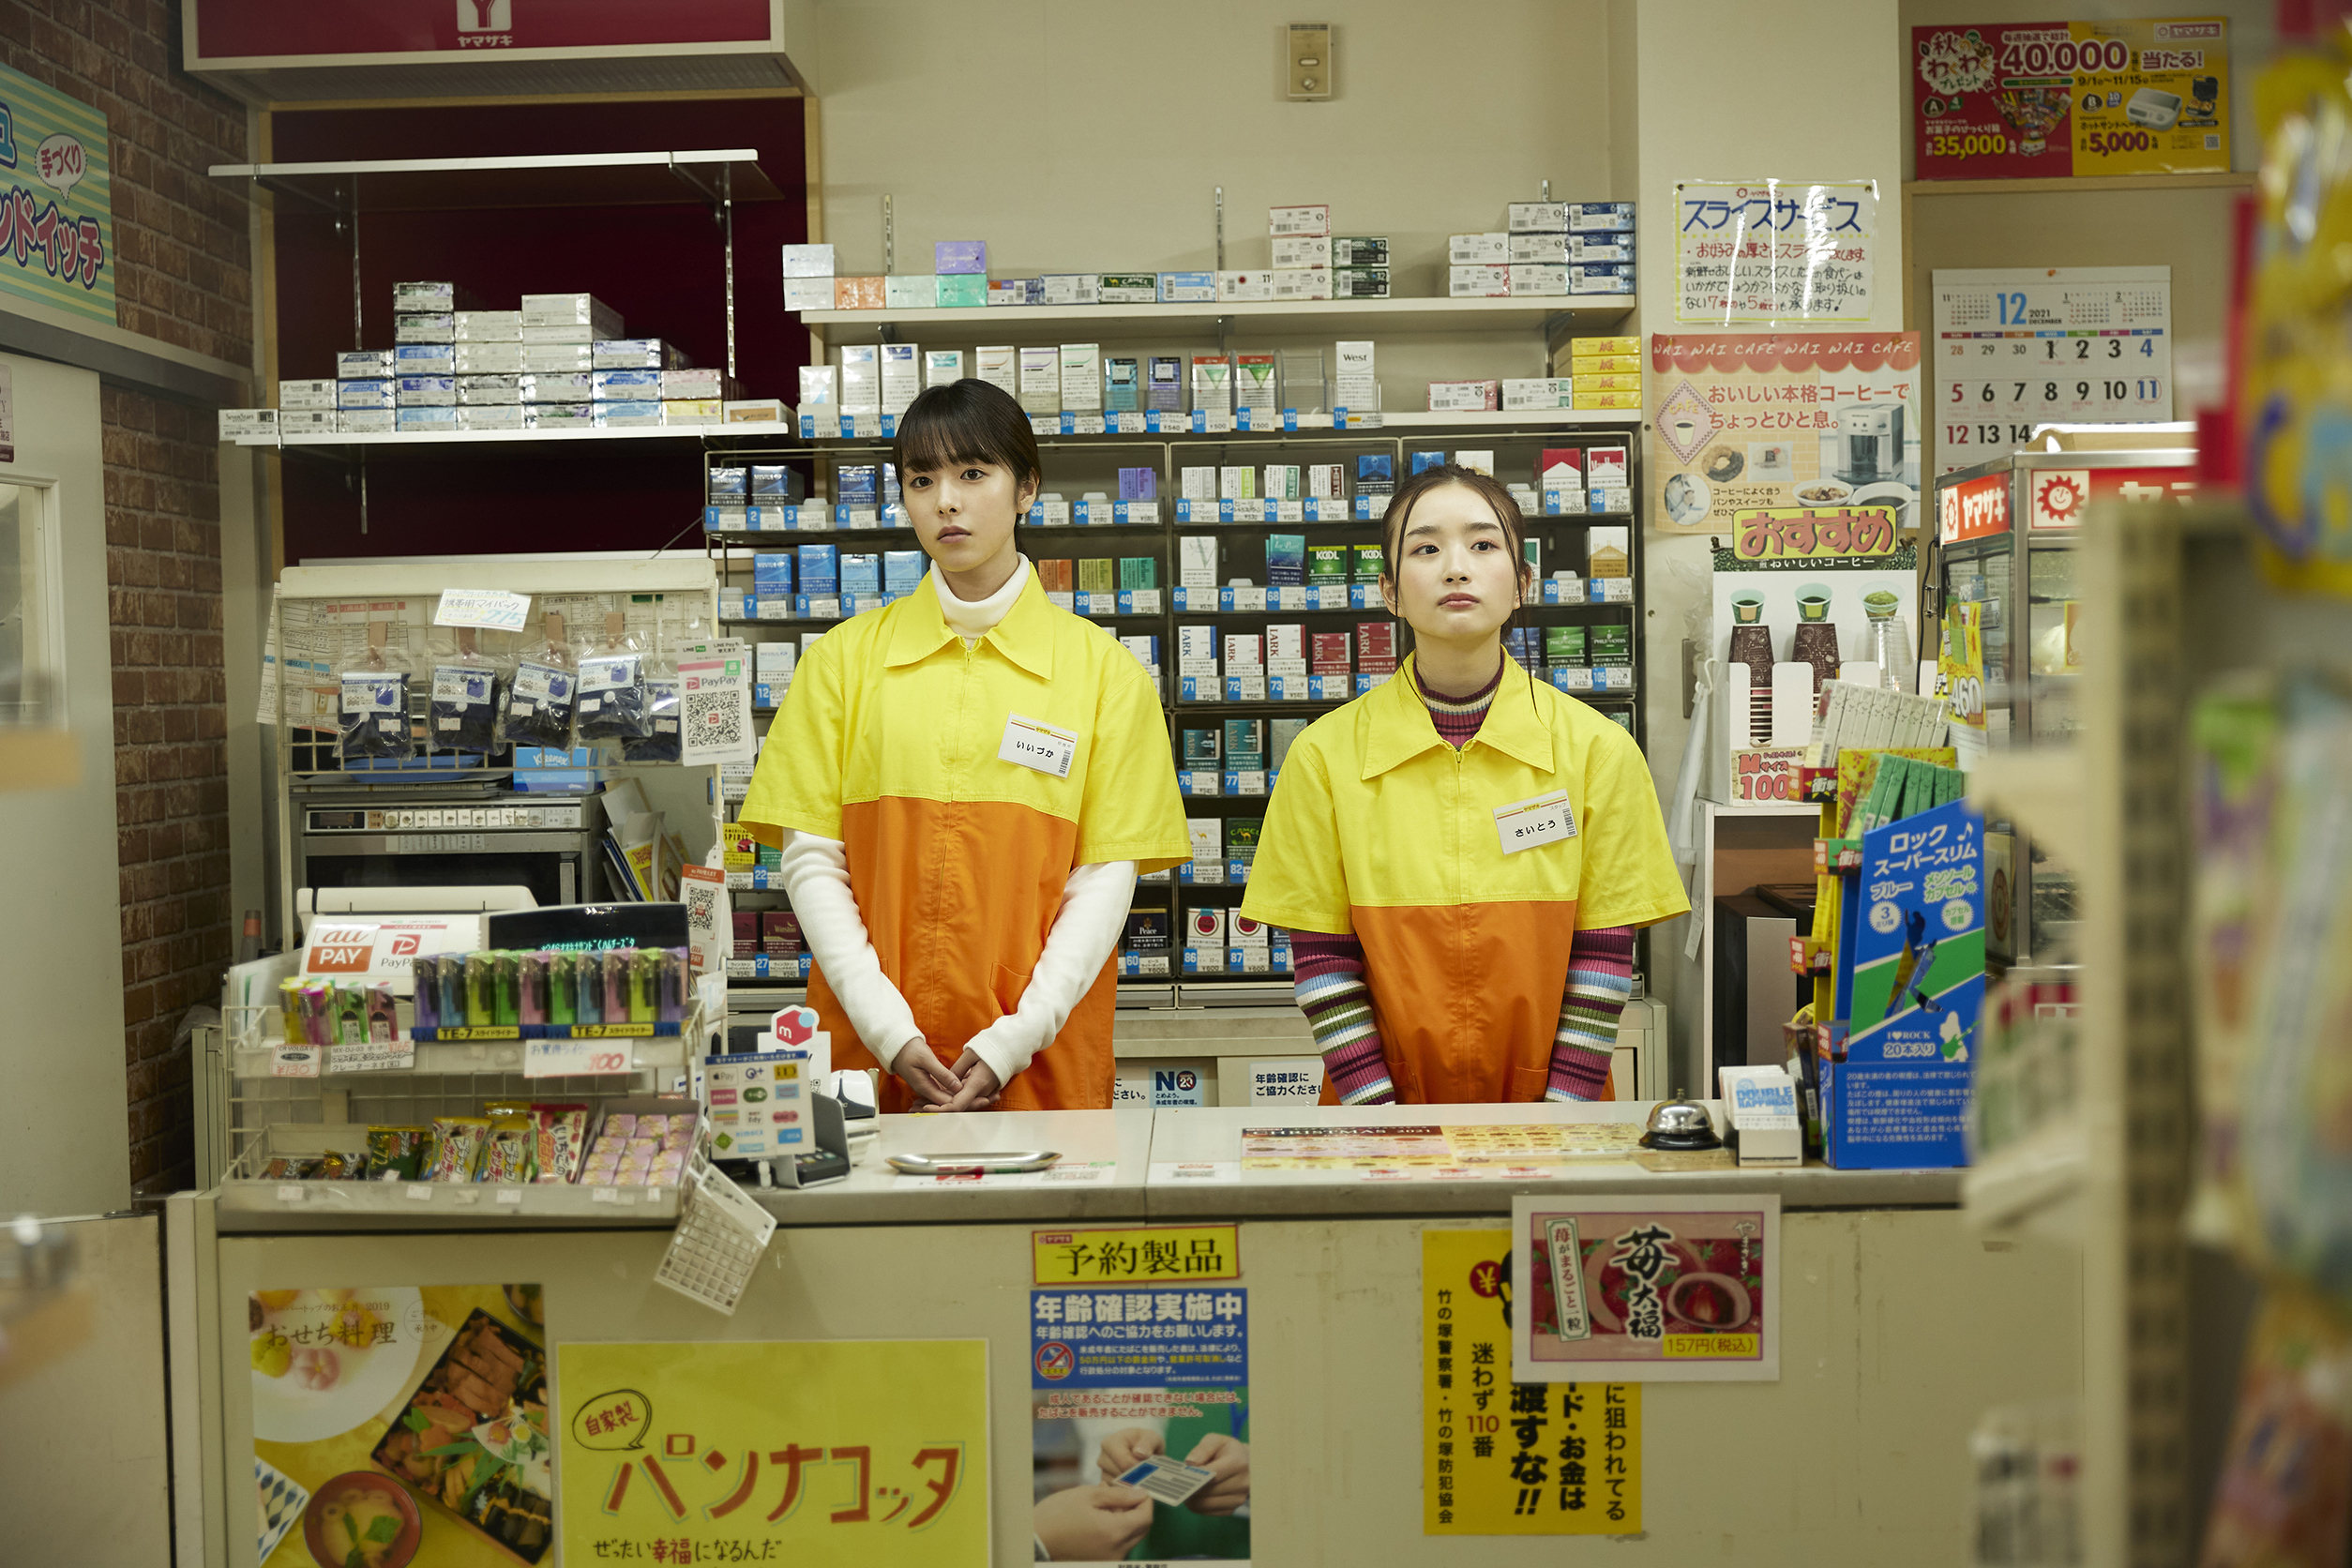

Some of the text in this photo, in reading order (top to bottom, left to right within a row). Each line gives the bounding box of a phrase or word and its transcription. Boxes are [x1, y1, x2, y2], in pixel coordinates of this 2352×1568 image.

[2173, 27, 2219, 37] ヤマザキ
[457, 36, 513, 47] ヤマザキ
[1933, 33, 1972, 55] 秋の
[2002, 41, 2204, 74] 40,000 当たる!
[1927, 54, 1989, 79] わくわく
[1939, 76, 1981, 89] プレゼント
[1934, 135, 2007, 160] 35,000
[2089, 131, 2149, 157] 5,000
[41, 144, 83, 178] 手づくり
[1683, 198, 1862, 233] スライスサス
[1262, 274, 1271, 283] 11
[1997, 293, 2027, 325] 12
[1691, 340, 1914, 356] WAI CAFE WAI CAFE
[1982, 339, 2153, 356] 29 30 4
[1343, 353, 1368, 363] West
[1708, 384, 1910, 403] おいしい本格コーヒーで
[2103, 381, 2127, 400] 10
[1669, 399, 1699, 415] CAFE
[800, 411, 1347, 430] 122 123 129 131 132 134
[1709, 411, 1840, 430] ちょっとひと息。
[1946, 425, 2030, 445] 12 13 14
[1547, 492, 1604, 505] 94 95
[1712, 488, 1781, 496] コーヒーによく合う
[1032, 500, 1369, 516] 33 34 61 62 63 65
[1712, 498, 1774, 506] パンやスイーツも
[1962, 487, 2006, 530] ヤマザキ
[750, 510, 758, 520] 2
[787, 510, 794, 520] 3
[1741, 508, 1894, 557] おすすめ
[1316, 550, 1340, 561] KOOL
[1770, 557, 1876, 569] おいしいコーヒー
[1545, 582, 1558, 595] 99
[445, 598, 520, 611] 携帯用マイバック
[746, 589, 1364, 610] 7 8 9 39 66 68 70
[1183, 626, 1370, 657] LARK LARK LARK
[701, 676, 738, 687] PayPay
[1183, 671, 1606, 691] 71 73 75 104 105
[1016, 741, 1055, 758] いいづか
[533, 753, 569, 767] Kleenex
[1739, 753, 1761, 775] M
[1179, 775, 1238, 786] 76 77
[1741, 774, 1788, 801] 100
[1550, 803, 1566, 811] スタッフ
[1515, 820, 1557, 837] さいとう
[1890, 824, 1948, 854] ロック
[1874, 842, 1978, 878] スーパースリム
[754, 864, 1244, 881] 22 81 82
[1924, 865, 1976, 886] メンソール
[1870, 882, 1914, 902] ブルー
[1924, 883, 1965, 904] カプセル
[1944, 905, 1970, 916] カプセル
[323, 929, 369, 943] au
[774, 925, 1157, 936] Winston Peace
[319, 948, 362, 965] PAY
[756, 952, 1286, 969] 60 87 88 27
[441, 1028, 517, 1039] TE-7 スライドライター
[575, 1025, 651, 1036] TE-7 スライドライター
[1903, 1032, 1931, 1040] ROCK
[388, 1042, 411, 1052] ¥165
[1883, 1042, 1936, 1059] 20本入り
[276, 1064, 309, 1076] ¥130
[720, 1072, 734, 1081] Pay
[1256, 1072, 1309, 1084] 年齢確認に
[1736, 1086, 1792, 1101] DOUBLE
[1738, 1095, 1795, 1109] HAPPINESS
[735, 1129, 763, 1138] nimoca
[454, 1137, 470, 1175] ブラック
[551, 1125, 567, 1177] いちごの
[504, 1140, 519, 1182] ブラック
[1047, 1235, 1072, 1244] ヤマザキ
[1056, 1238, 1222, 1277] 予約製品
[1553, 1226, 1583, 1333] 苺がまるごと一粒
[1609, 1224, 1679, 1340] 苺大福
[365, 1302, 391, 1312] 2019
[1034, 1292, 1243, 1323] 年齢確認実施中
[266, 1320, 398, 1347] おせち料理
[1035, 1324, 1244, 1339] 年齢確認へのご協力をお願いします。
[1079, 1343, 1243, 1354] 未成年者にたばこを販売した者は、法律により、
[1666, 1335, 1754, 1355] 157円(税込)
[1079, 1354, 1243, 1364] 50万円以下の罰金刑や、営業許可取消しなど
[1079, 1365, 1177, 1376] 行政処分の対象となります。
[1048, 1392, 1243, 1406] 成人であることが確認できない場合には、
[1438, 1289, 1454, 1525] 竹の塚警察署・竹の塚防犯協会
[1466, 1342, 1500, 1459] 迷わず110番
[583, 1400, 641, 1437] 自家製
[1037, 1407, 1204, 1420] たばこを販売することができません。
[1604, 1384, 1628, 1521] に狙われてる
[607, 1434, 960, 1530] パンナコッタ
[593, 1538, 782, 1565] ぜったい幸福になるんだ
